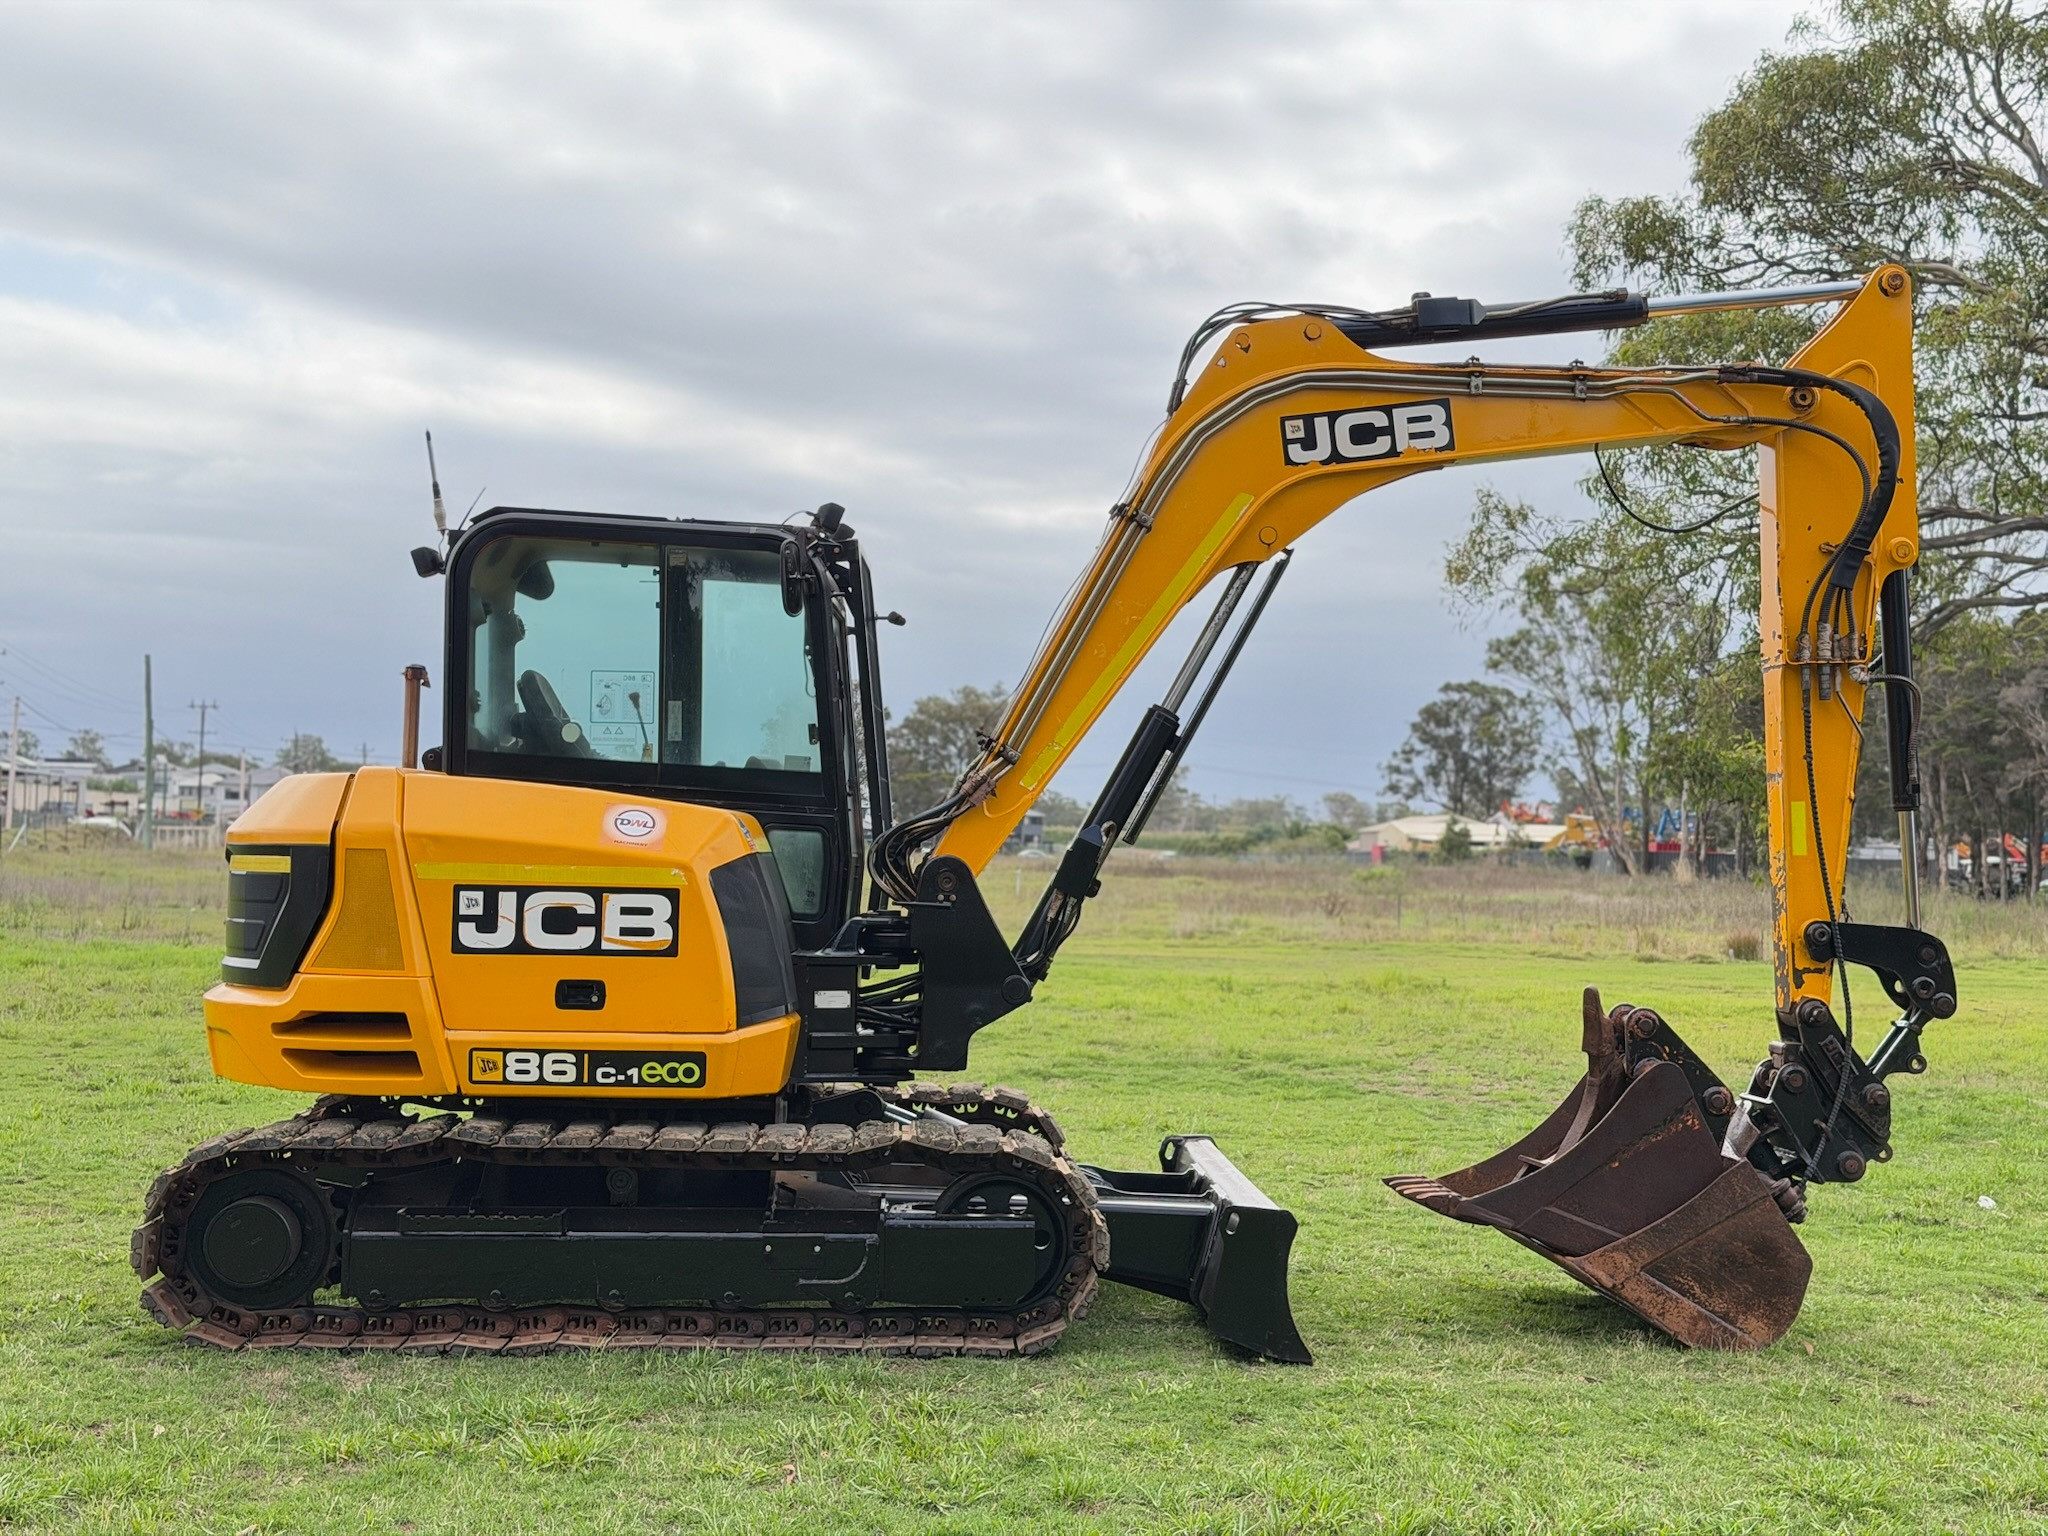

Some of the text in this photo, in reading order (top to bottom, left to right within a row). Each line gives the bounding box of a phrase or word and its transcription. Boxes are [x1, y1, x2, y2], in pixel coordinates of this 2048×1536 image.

[1287, 404, 1450, 464] JCB
[617, 818, 655, 829] DWL
[458, 891, 673, 950] JCB
[481, 1058, 498, 1073] JCB
[505, 1051, 577, 1083] 86
